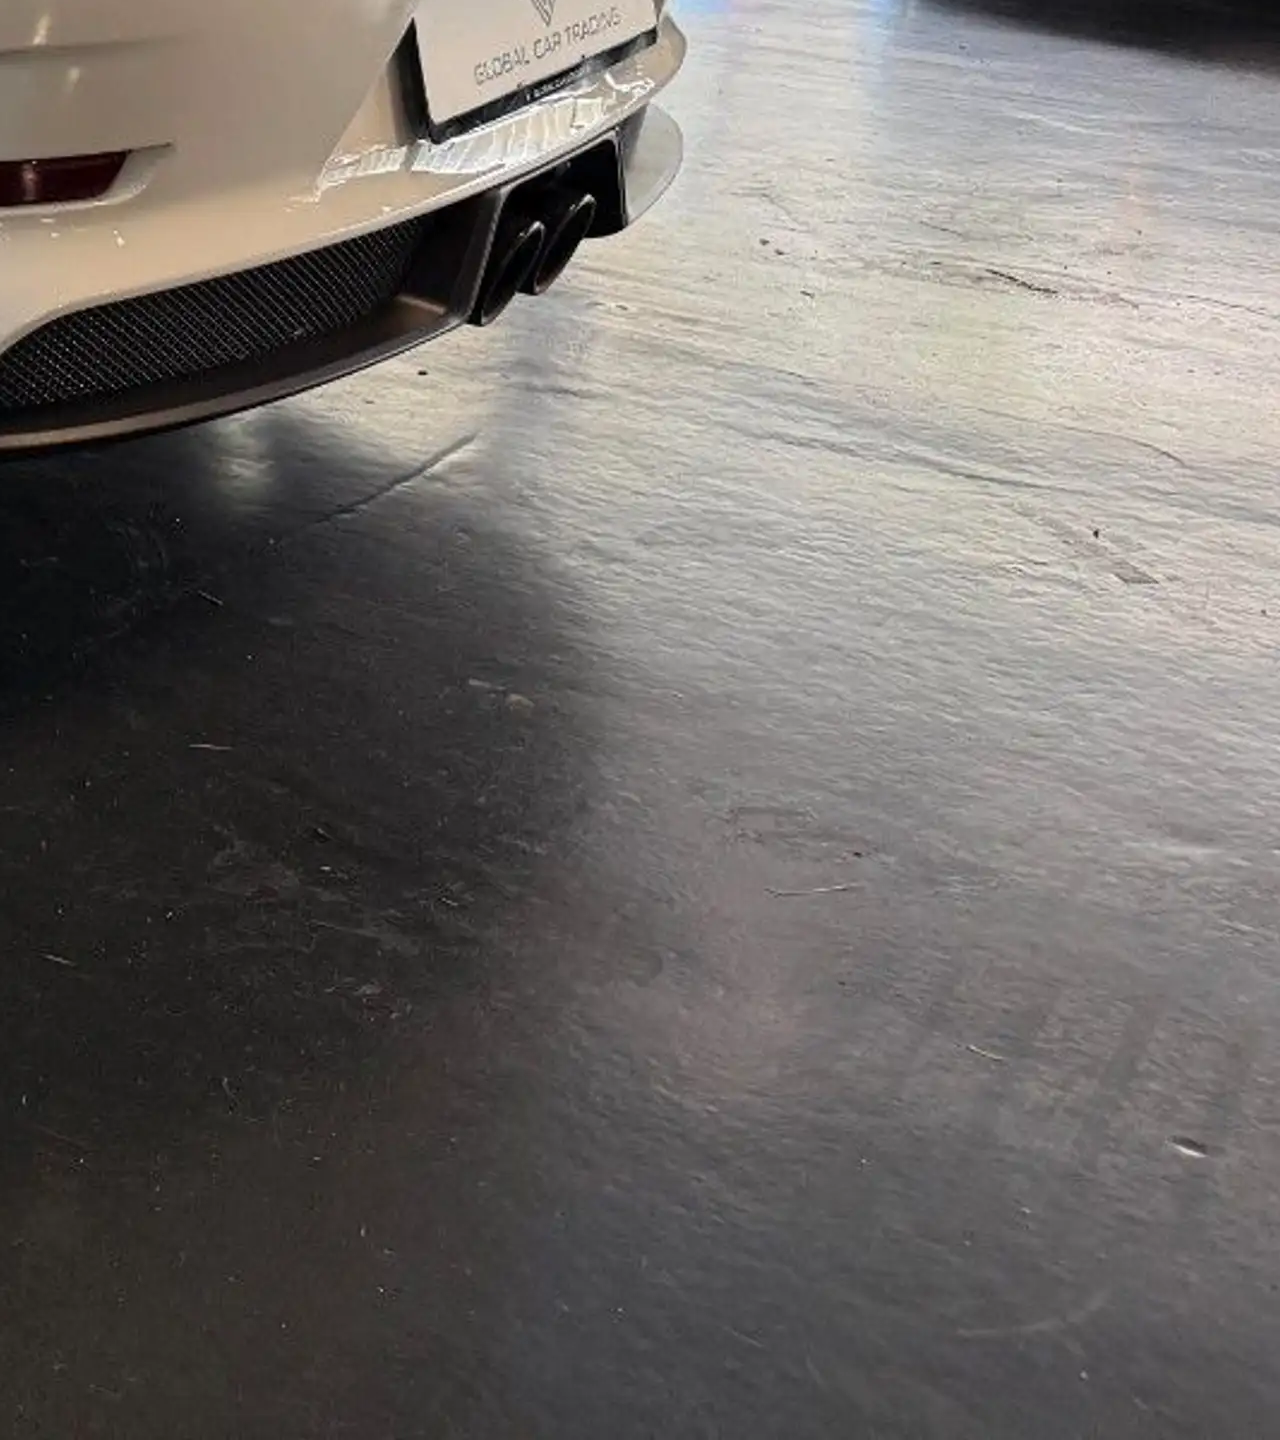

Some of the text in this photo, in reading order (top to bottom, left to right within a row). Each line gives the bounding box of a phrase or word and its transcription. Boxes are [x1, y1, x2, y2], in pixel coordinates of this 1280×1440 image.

[474, 45, 530, 85] GLOBAL
[533, 32, 562, 59] CAR
[564, 7, 622, 45] TRADING
